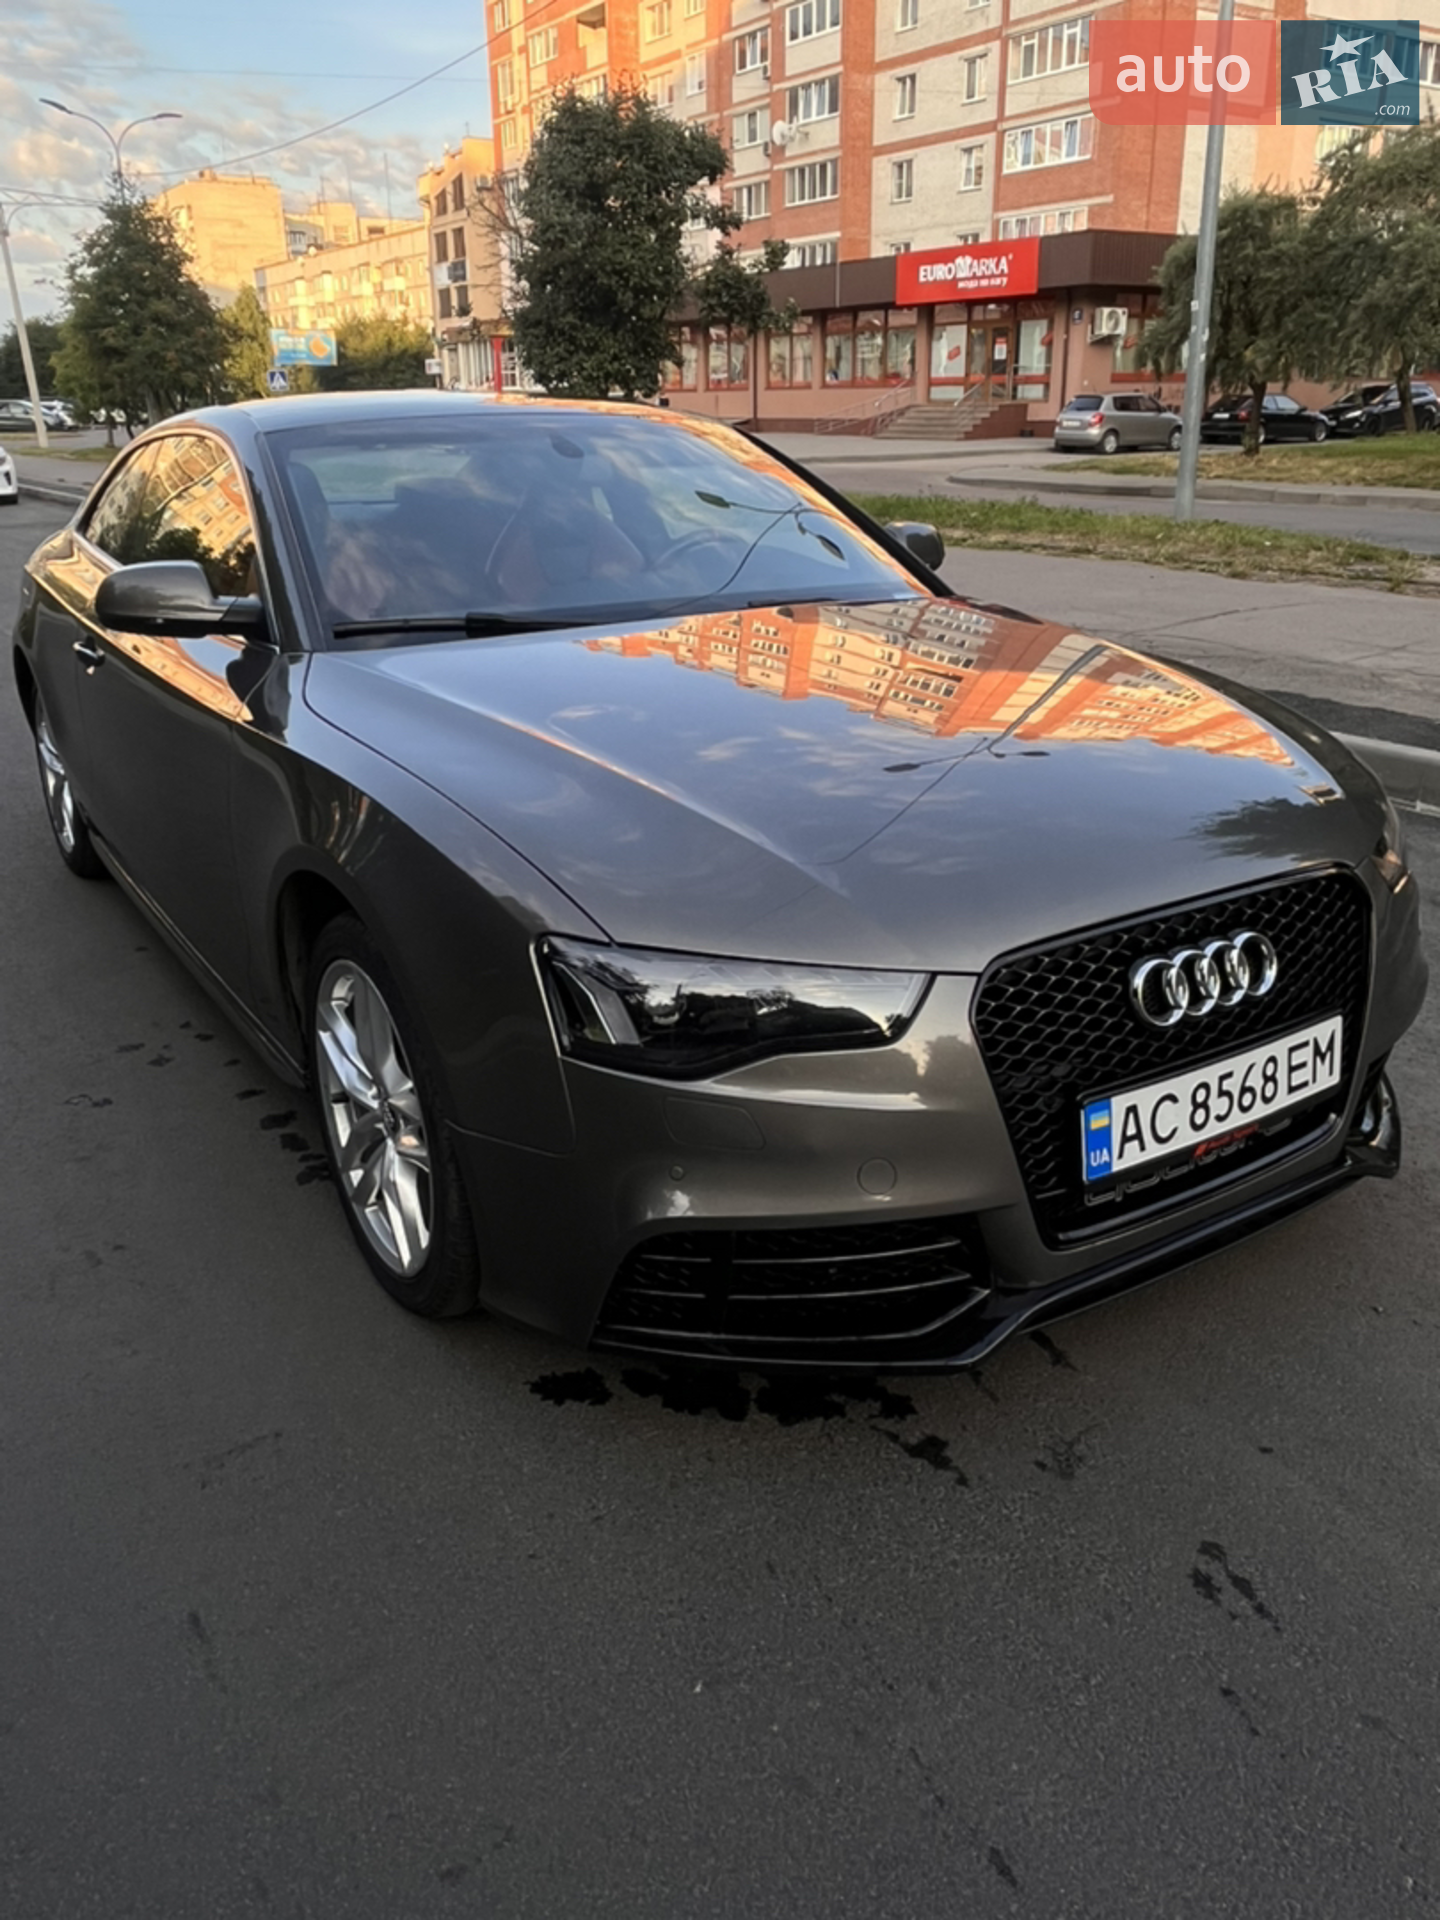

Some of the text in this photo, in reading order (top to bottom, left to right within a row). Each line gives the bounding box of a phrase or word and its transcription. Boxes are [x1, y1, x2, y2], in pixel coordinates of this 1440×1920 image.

[1117, 1093, 1180, 1160] AC
[1189, 1055, 1279, 1132] 8568
[1287, 1029, 1336, 1095] EM
[1090, 1148, 1110, 1167] UA
